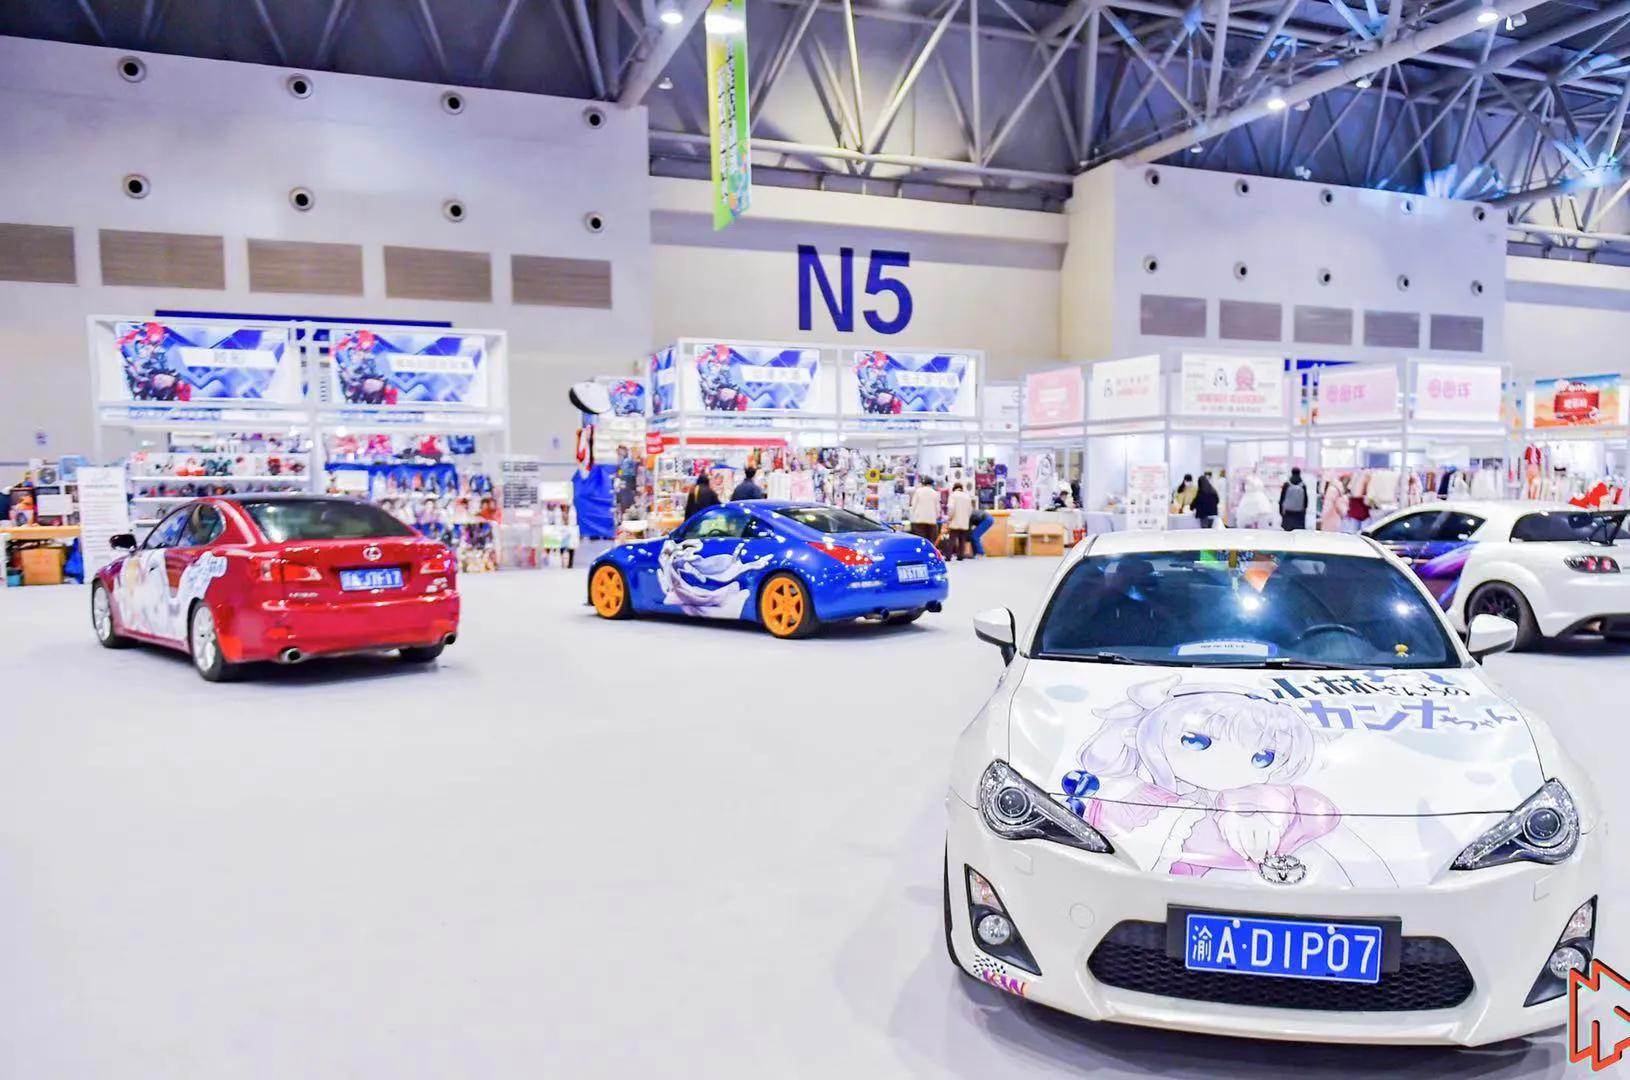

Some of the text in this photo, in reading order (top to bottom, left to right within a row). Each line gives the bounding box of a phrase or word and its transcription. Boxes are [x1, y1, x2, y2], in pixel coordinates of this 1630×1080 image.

[798, 244, 913, 335] N5
[1271, 674, 1471, 699] 小林さんちの
[1301, 699, 1518, 731] カンナちゃん
